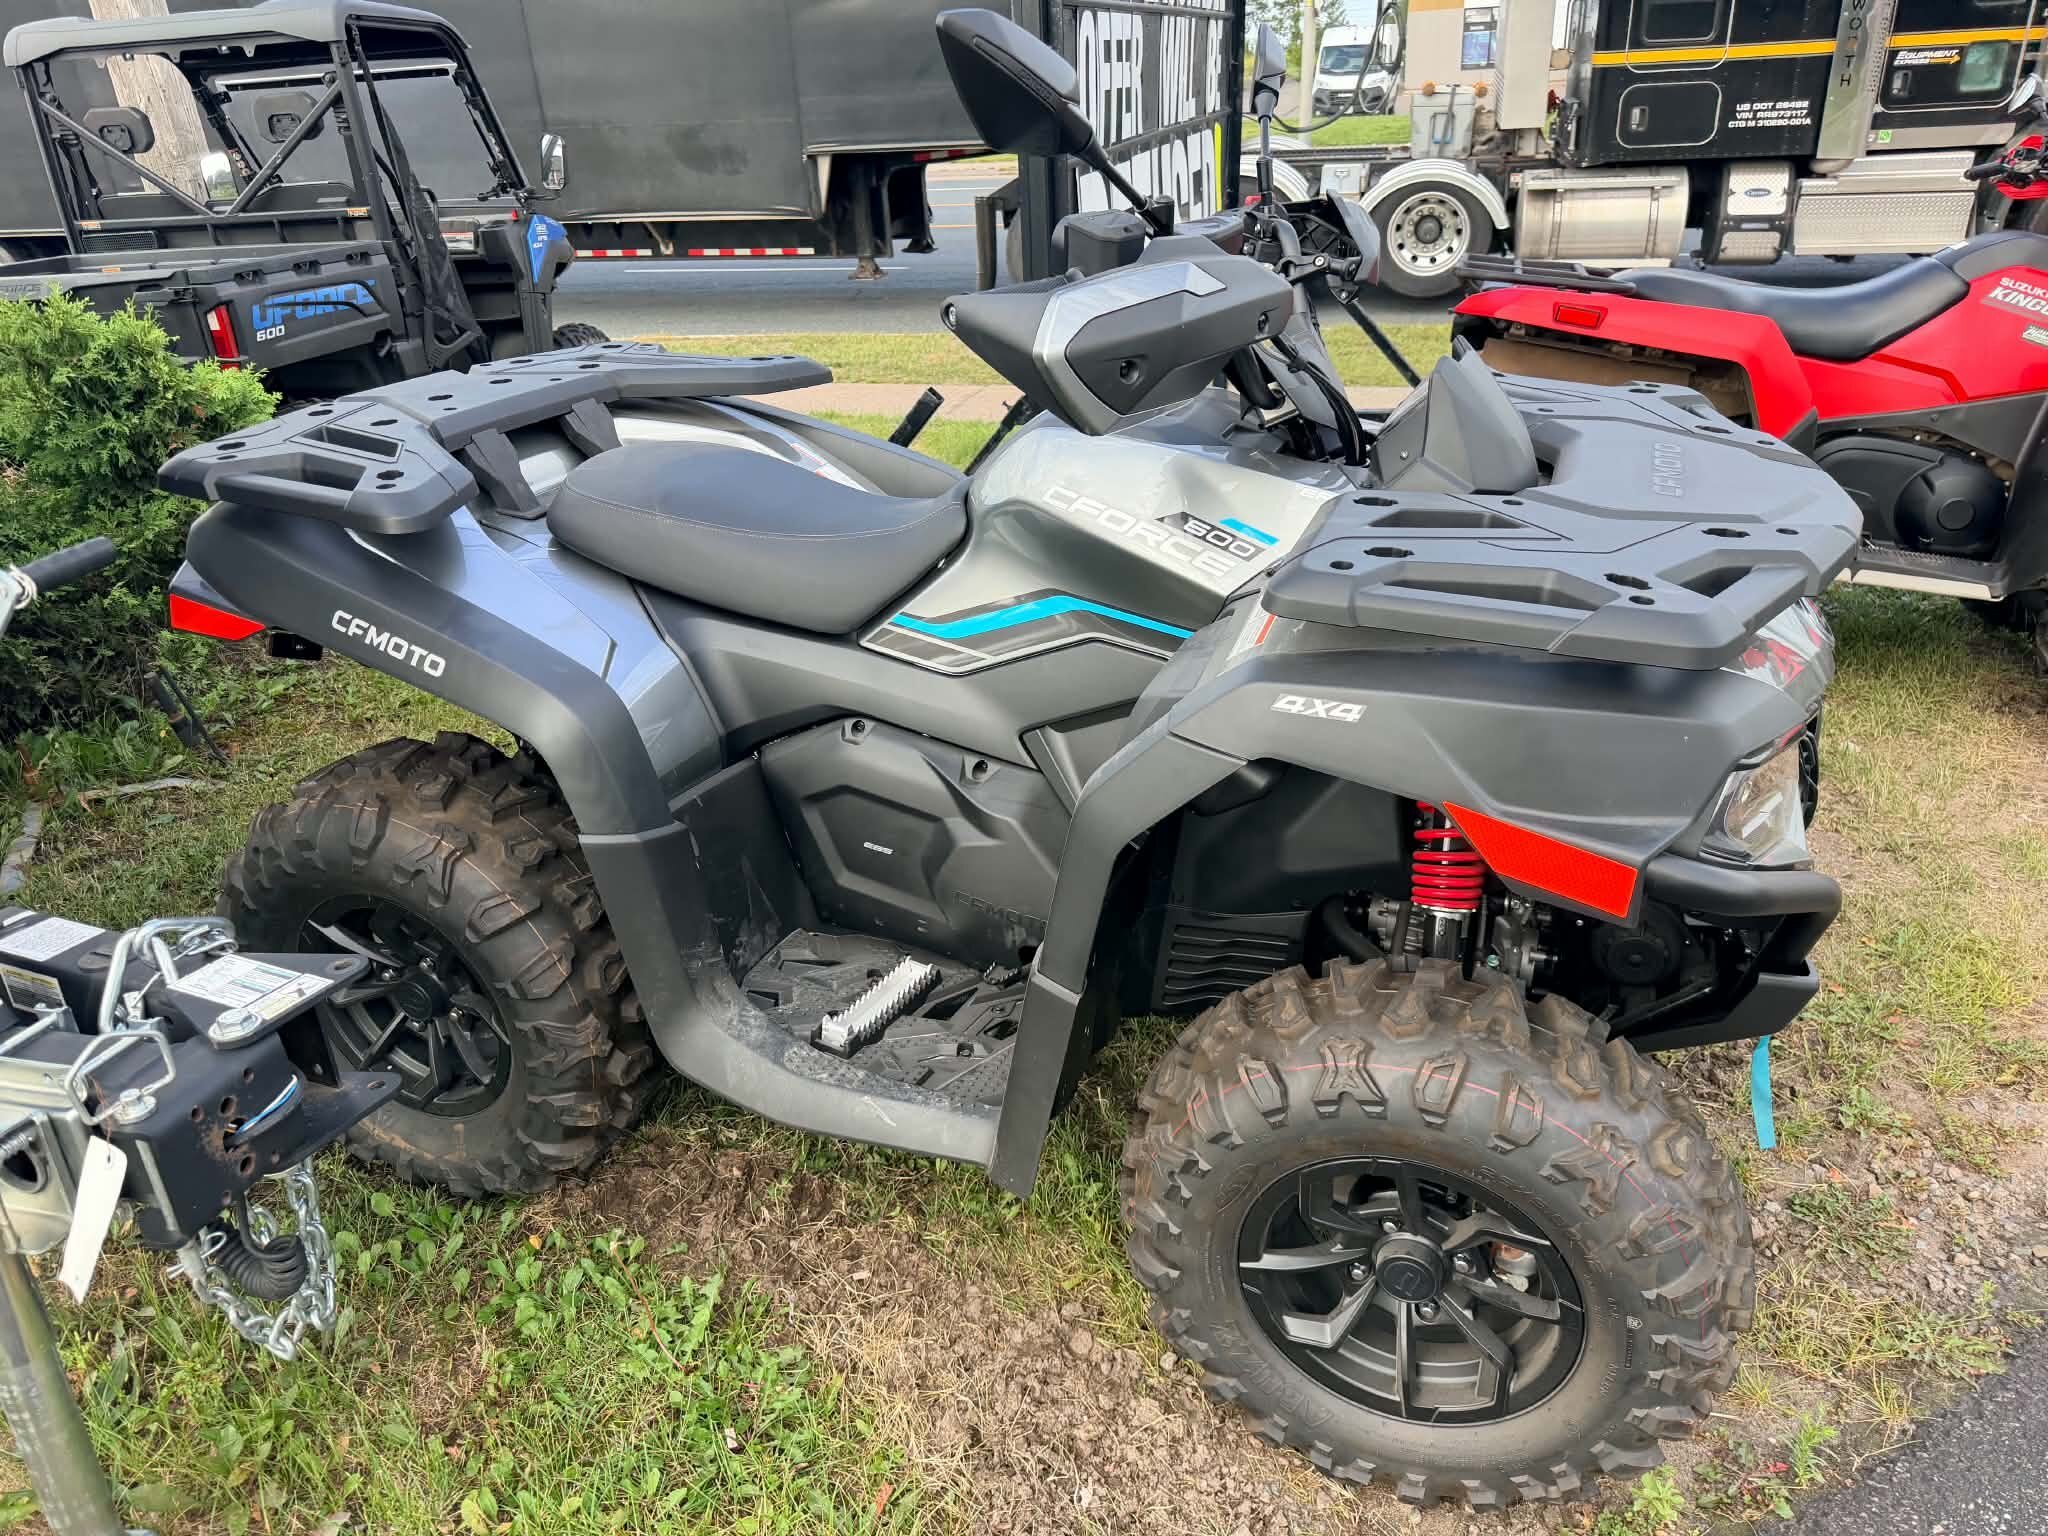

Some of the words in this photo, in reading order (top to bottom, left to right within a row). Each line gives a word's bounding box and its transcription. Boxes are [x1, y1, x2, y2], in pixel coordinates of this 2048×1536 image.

[1895, 49, 1960, 61] EQUIPMENT
[1079, 10, 1143, 148] OFFER
[1159, 15, 1196, 128] WILL
[1206, 18, 1224, 115] BE
[1736, 111, 1753, 119] VIN
[1753, 102, 1773, 111] DOT
[252, 280, 376, 330] UFORCE
[256, 324, 285, 342] 600
[1042, 487, 1236, 577] CFORCE
[1183, 519, 1256, 557] 600
[331, 609, 446, 678] CFMOTO
